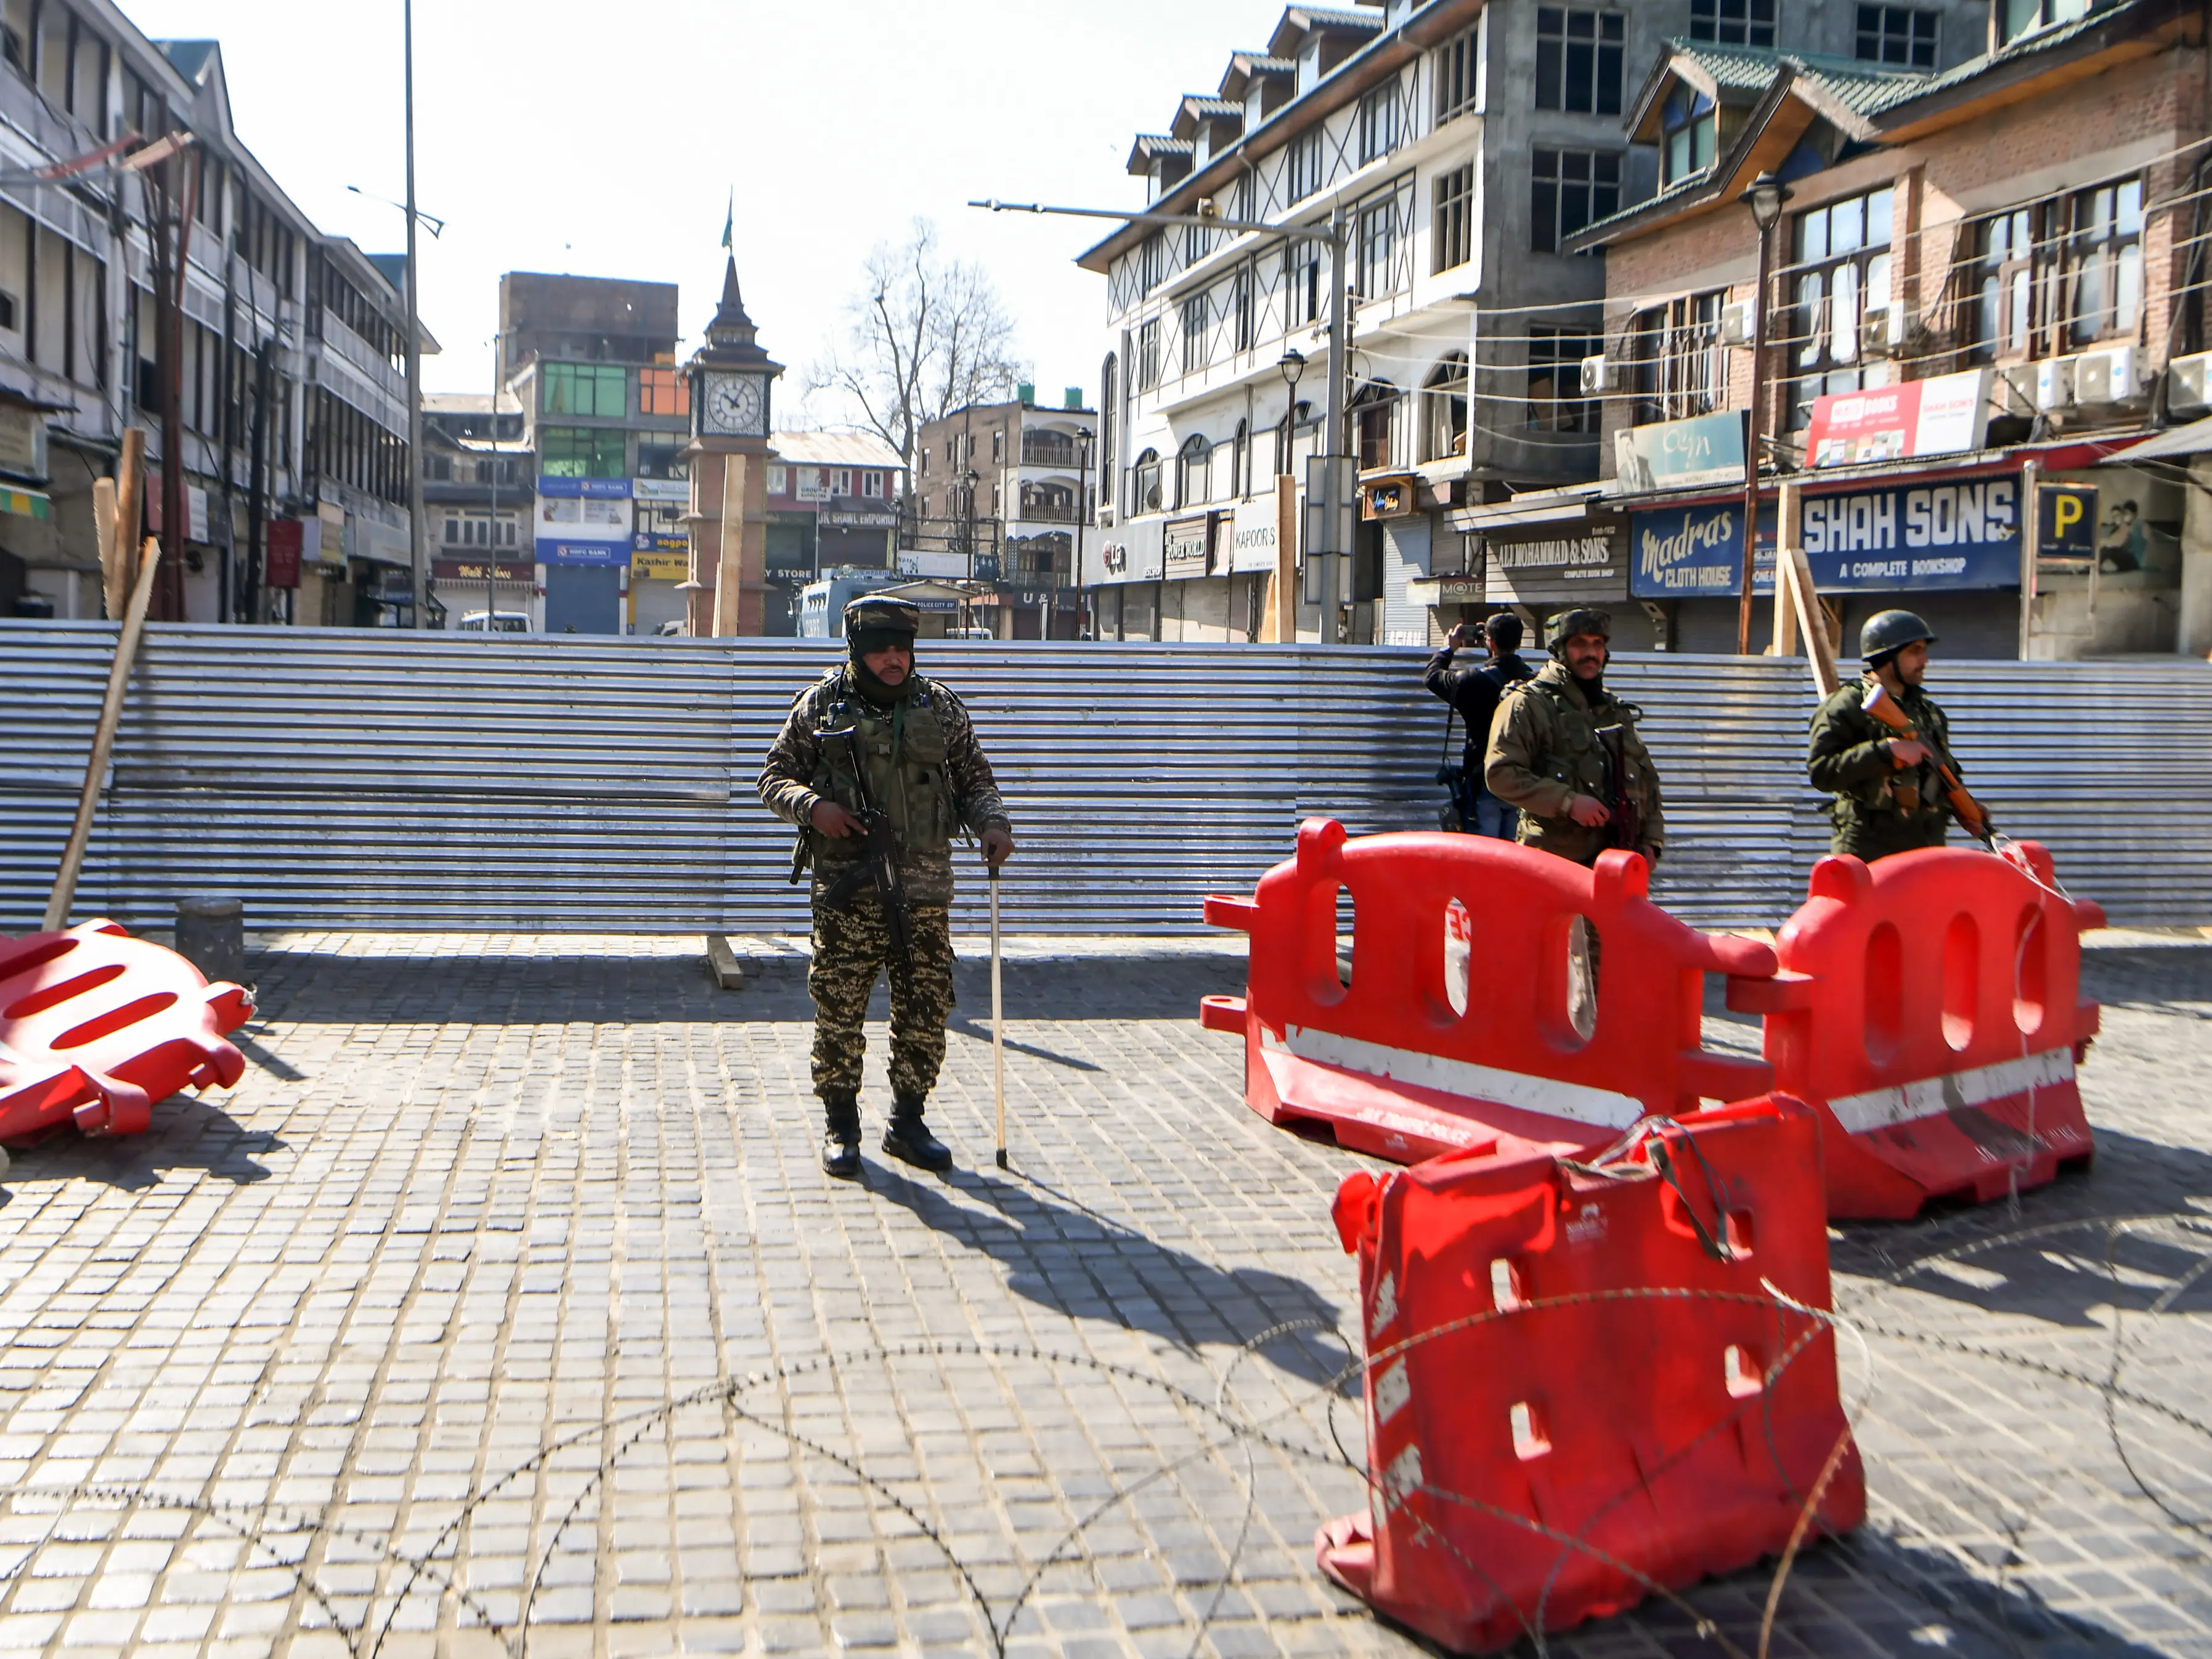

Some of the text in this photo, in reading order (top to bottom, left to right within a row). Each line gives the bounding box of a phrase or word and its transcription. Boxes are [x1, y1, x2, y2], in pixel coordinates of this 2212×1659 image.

[832, 512, 858, 524] SHAWL
[1804, 481, 2014, 554] SHAH SONS
[2054, 494, 2084, 539] P
[1168, 539, 1205, 558] POWER WORLD
[1235, 528, 1268, 549] KAPOOR
[1641, 511, 1732, 583] Madras
[1498, 537, 1609, 568] ALI MOHAMMAD & SONS
[778, 569, 811, 579] STORE
[1665, 566, 1732, 588] CLOTH HOUSE
[1839, 557, 1966, 579] A COMPLETE BOOKSHOP
[1023, 592, 1033, 604] U
